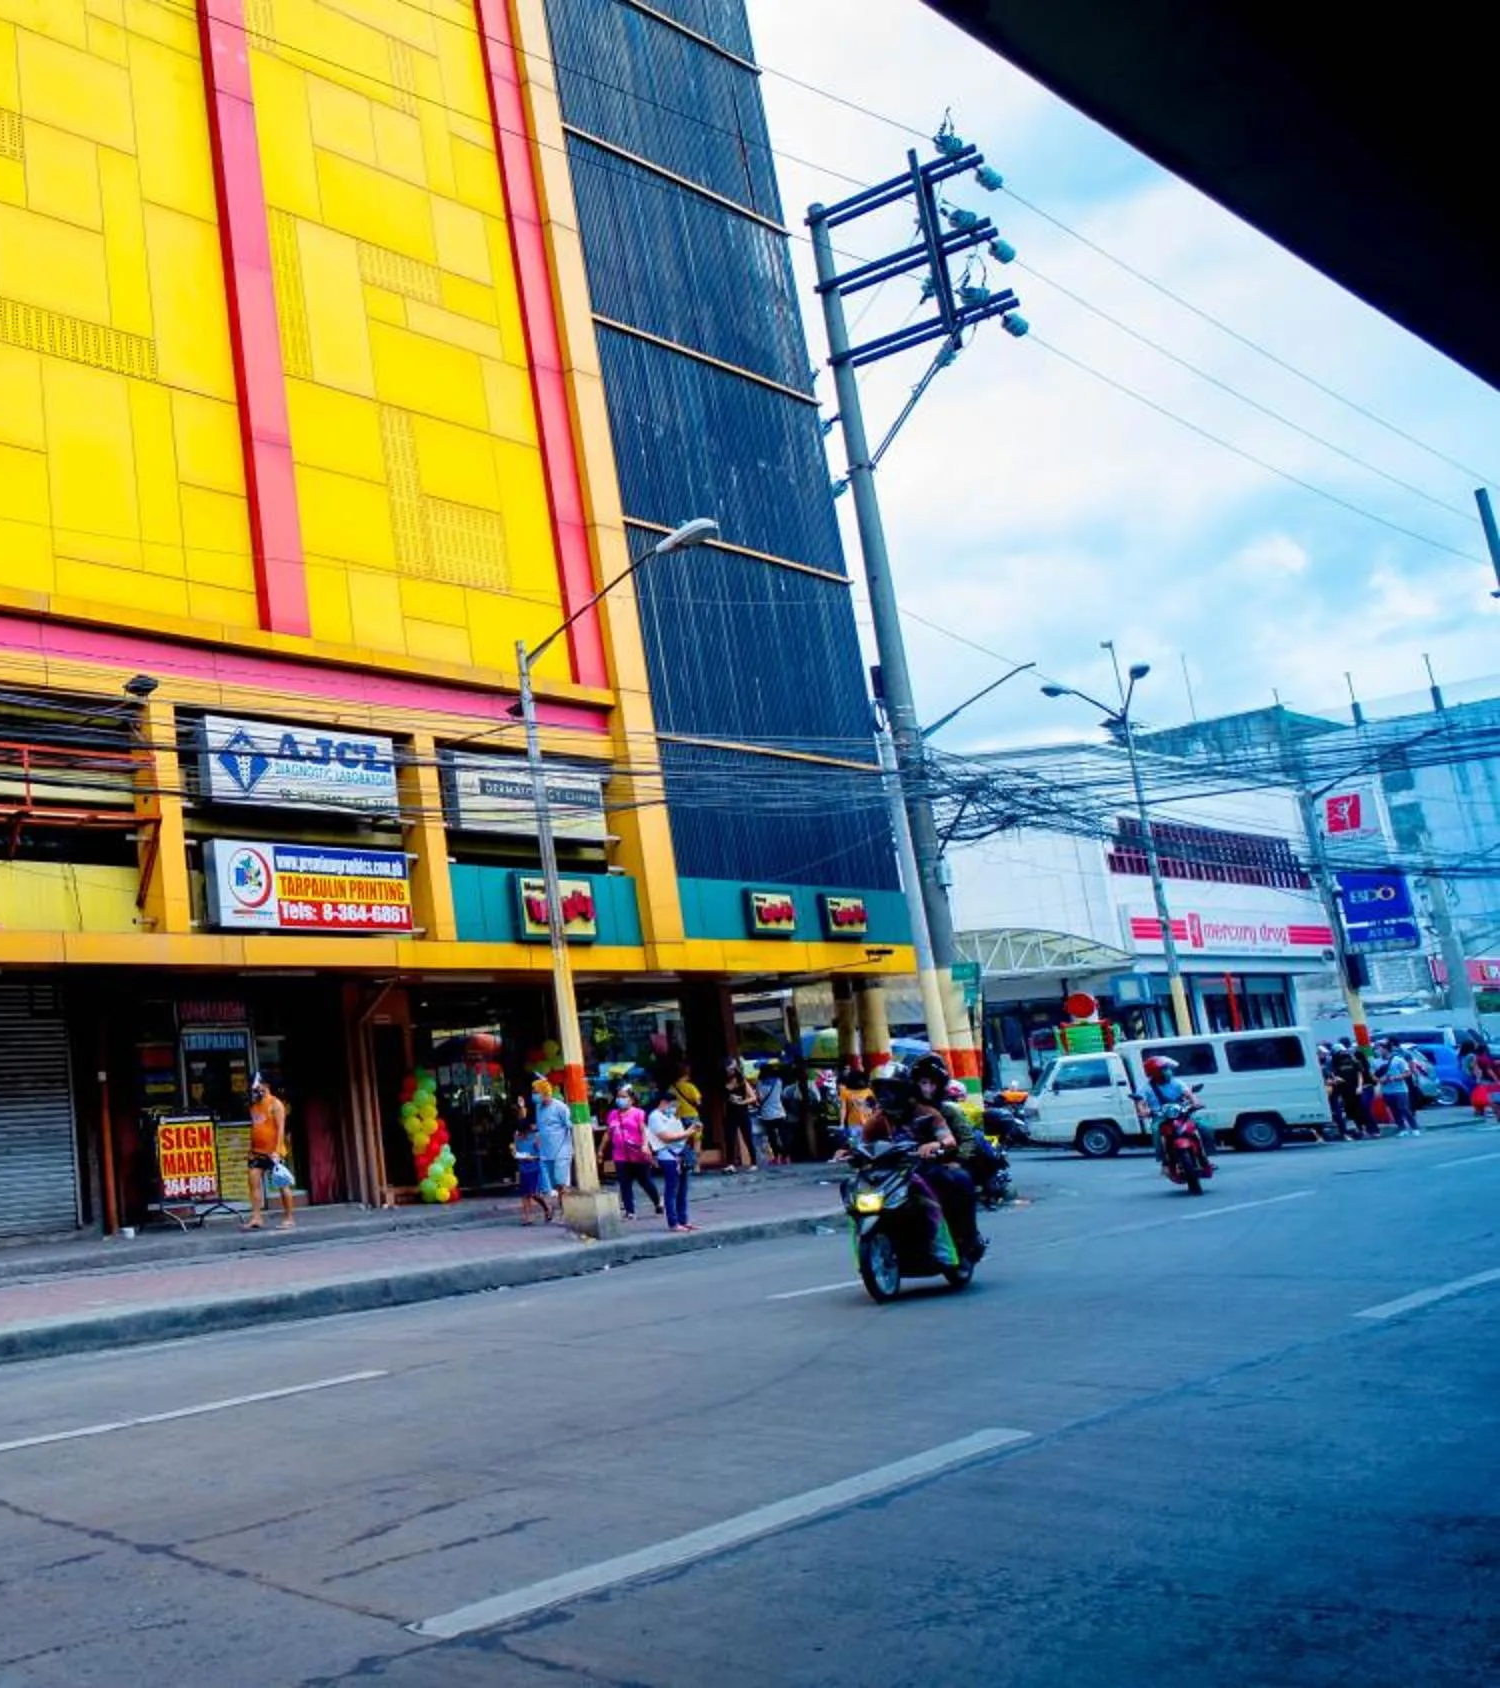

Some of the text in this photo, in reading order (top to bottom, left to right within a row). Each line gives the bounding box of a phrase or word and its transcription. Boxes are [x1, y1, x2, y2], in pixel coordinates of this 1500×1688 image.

[279, 875, 405, 901] TARPAULIN PRINTING
[280, 900, 317, 921] Tels:
[1204, 921, 1288, 946] mercury drug
[160, 1126, 212, 1150] SIGN
[163, 1151, 213, 1176] MAKER
